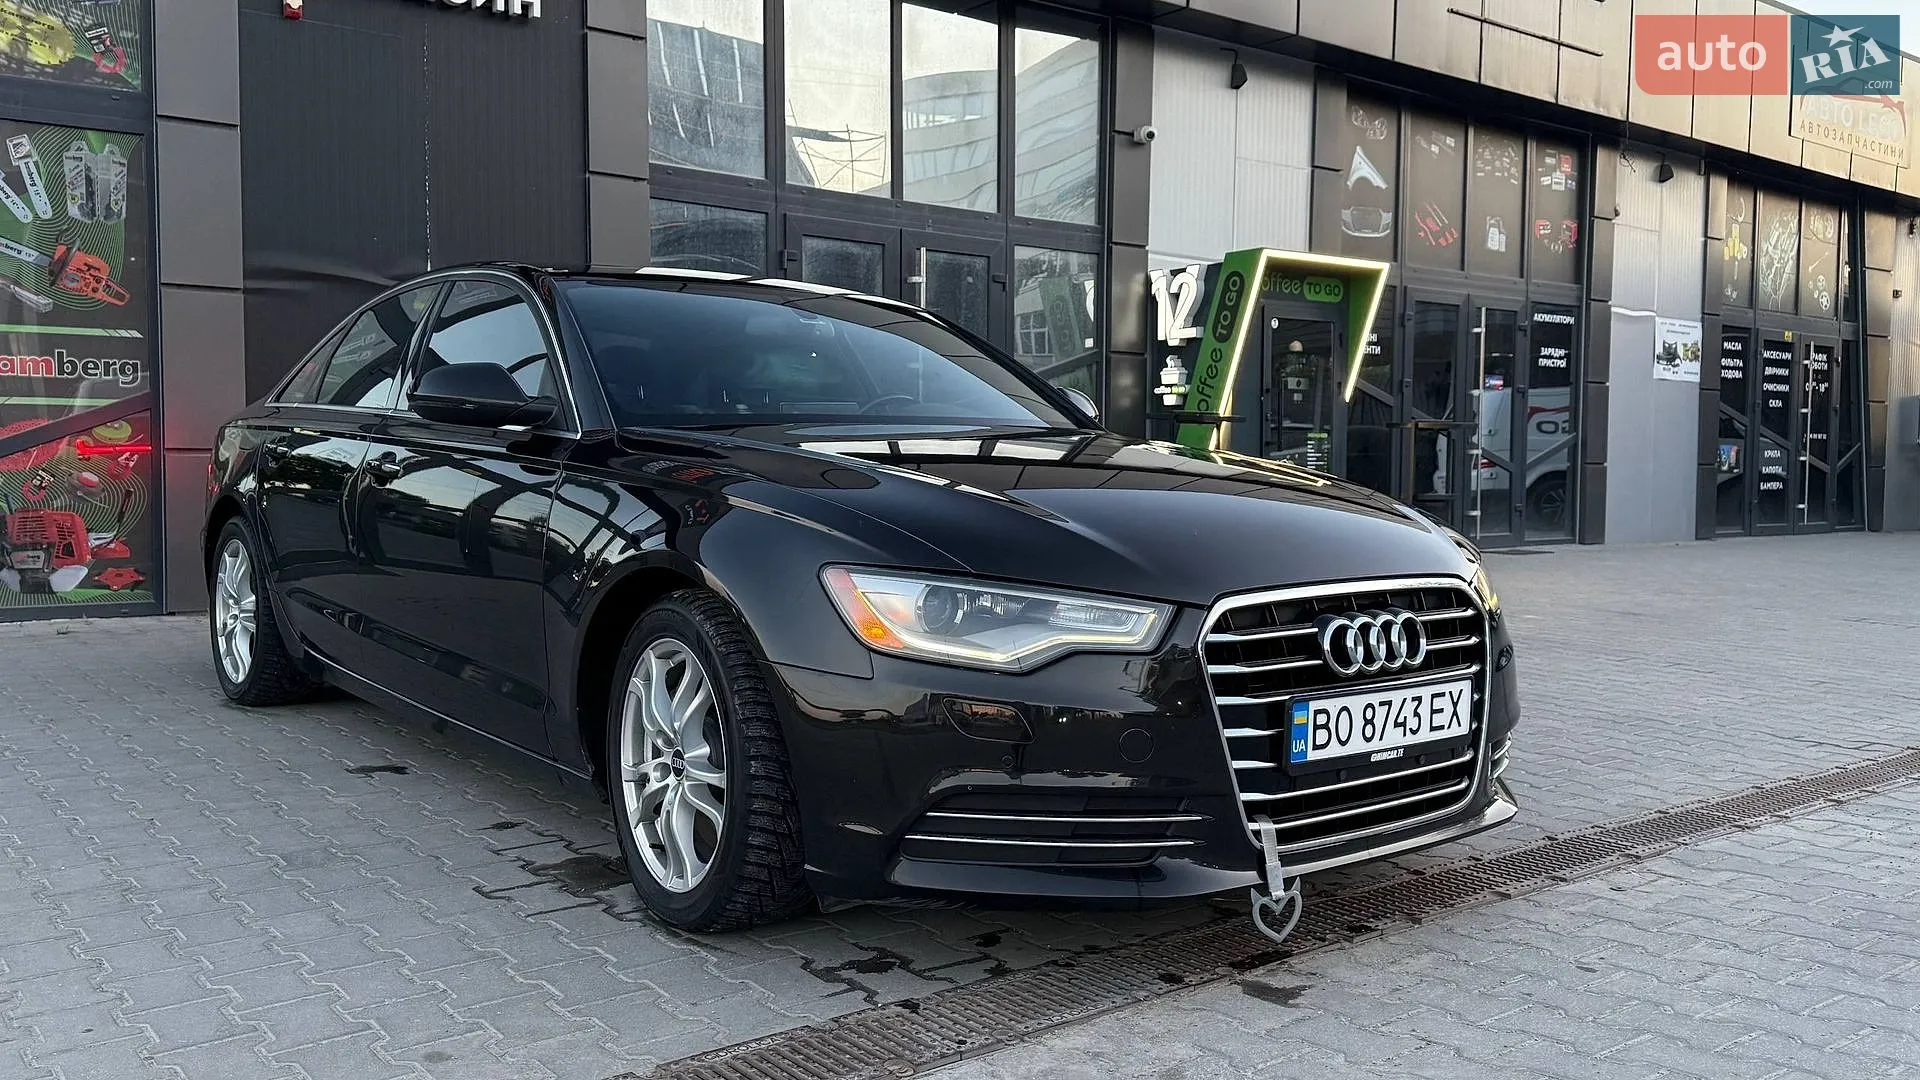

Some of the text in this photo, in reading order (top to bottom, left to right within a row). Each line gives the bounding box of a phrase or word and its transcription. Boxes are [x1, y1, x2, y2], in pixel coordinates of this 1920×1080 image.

[1800, 119, 1904, 160] АВТОЗАПЧАСТИНИ
[1262, 272, 1341, 297] offee TO GO
[1533, 313, 1575, 325] АКУМУЛЯТОРИ
[1197, 276, 1241, 411] offee TO GO
[1723, 341, 1742, 351] МАСЛА
[1762, 350, 1792, 361] АКСЕСУАРИ
[1768, 399, 1783, 408] СКЛА
[1312, 689, 1464, 751] BO 8743 EX
[1292, 739, 1306, 753] UA
